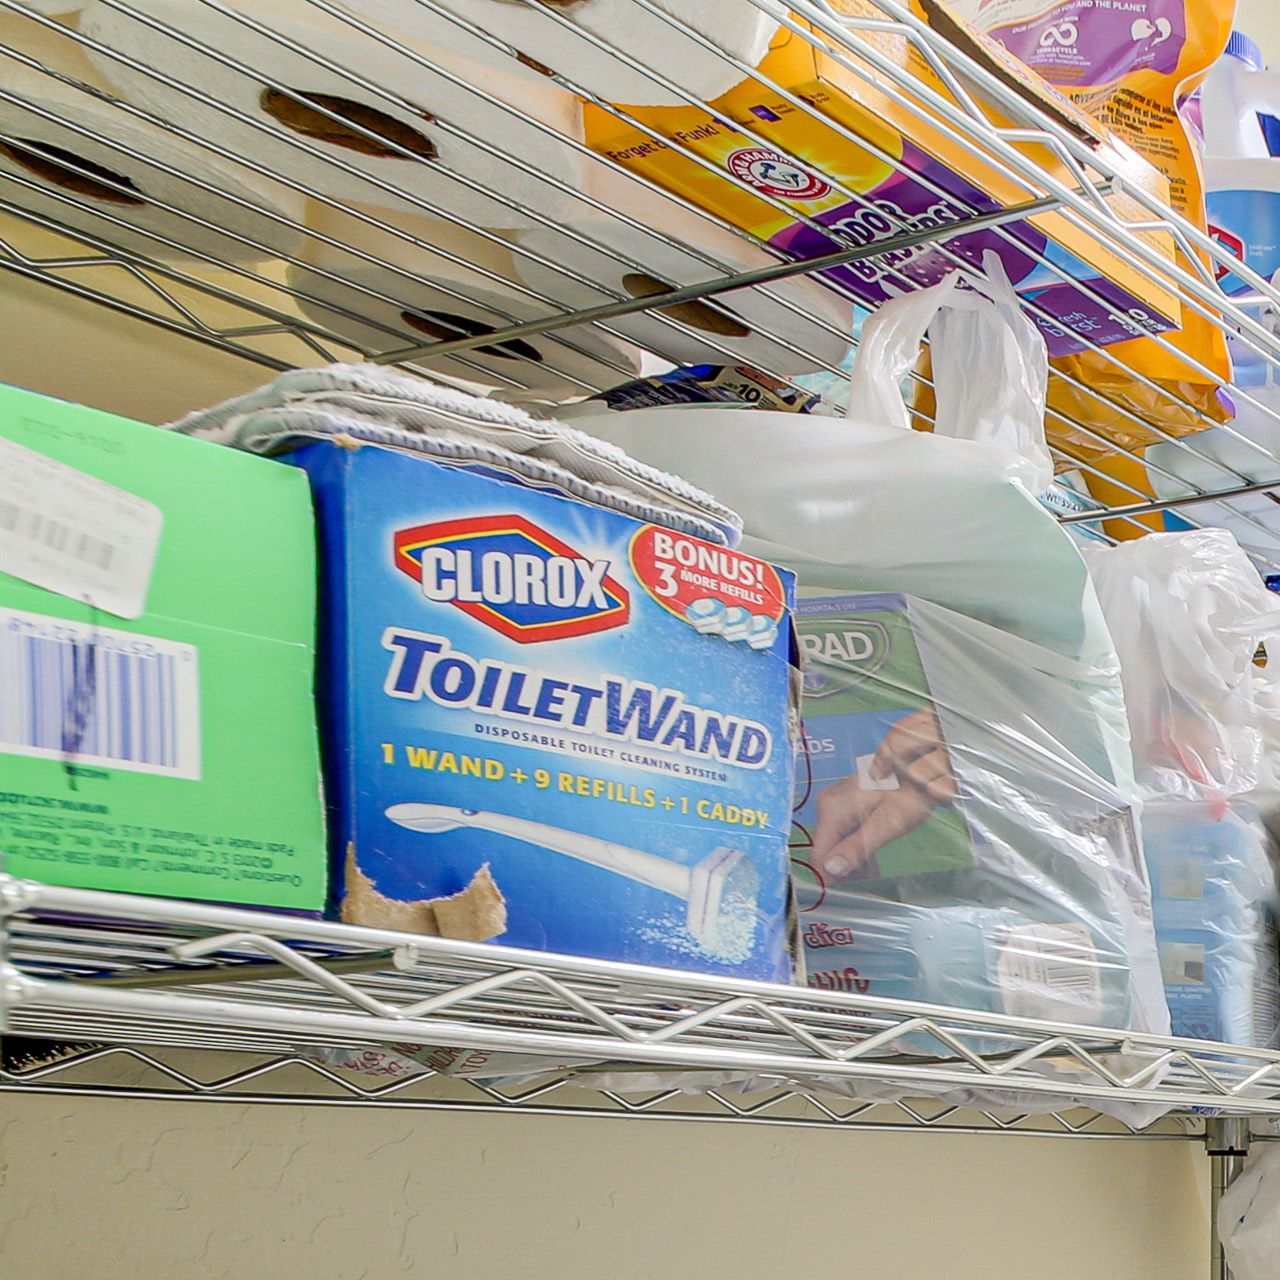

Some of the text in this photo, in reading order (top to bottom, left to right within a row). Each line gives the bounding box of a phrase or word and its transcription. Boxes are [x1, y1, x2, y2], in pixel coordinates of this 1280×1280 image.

[1076, 0, 1093, 9] AND
[1095, 0, 1110, 10] THE
[1112, 3, 1147, 13] PLANET
[606, 142, 659, 161] Forget
[675, 124, 720, 143] Funk!
[421, 546, 612, 611] CLOROX
[653, 531, 765, 591] BONUS!
[653, 561, 764, 607] 3 MORE REFILLS
[799, 631, 874, 664] RAD
[474, 723, 729, 784] DISPOSABLE TOILET CLEANING SYSTEM
[380, 742, 396, 765] 1
[405, 745, 506, 781] WAND
[534, 768, 552, 790] 9
[557, 772, 657, 809] REFILLS
[695, 799, 770, 832] CADDY
[234, 868, 303, 889] Questions?
